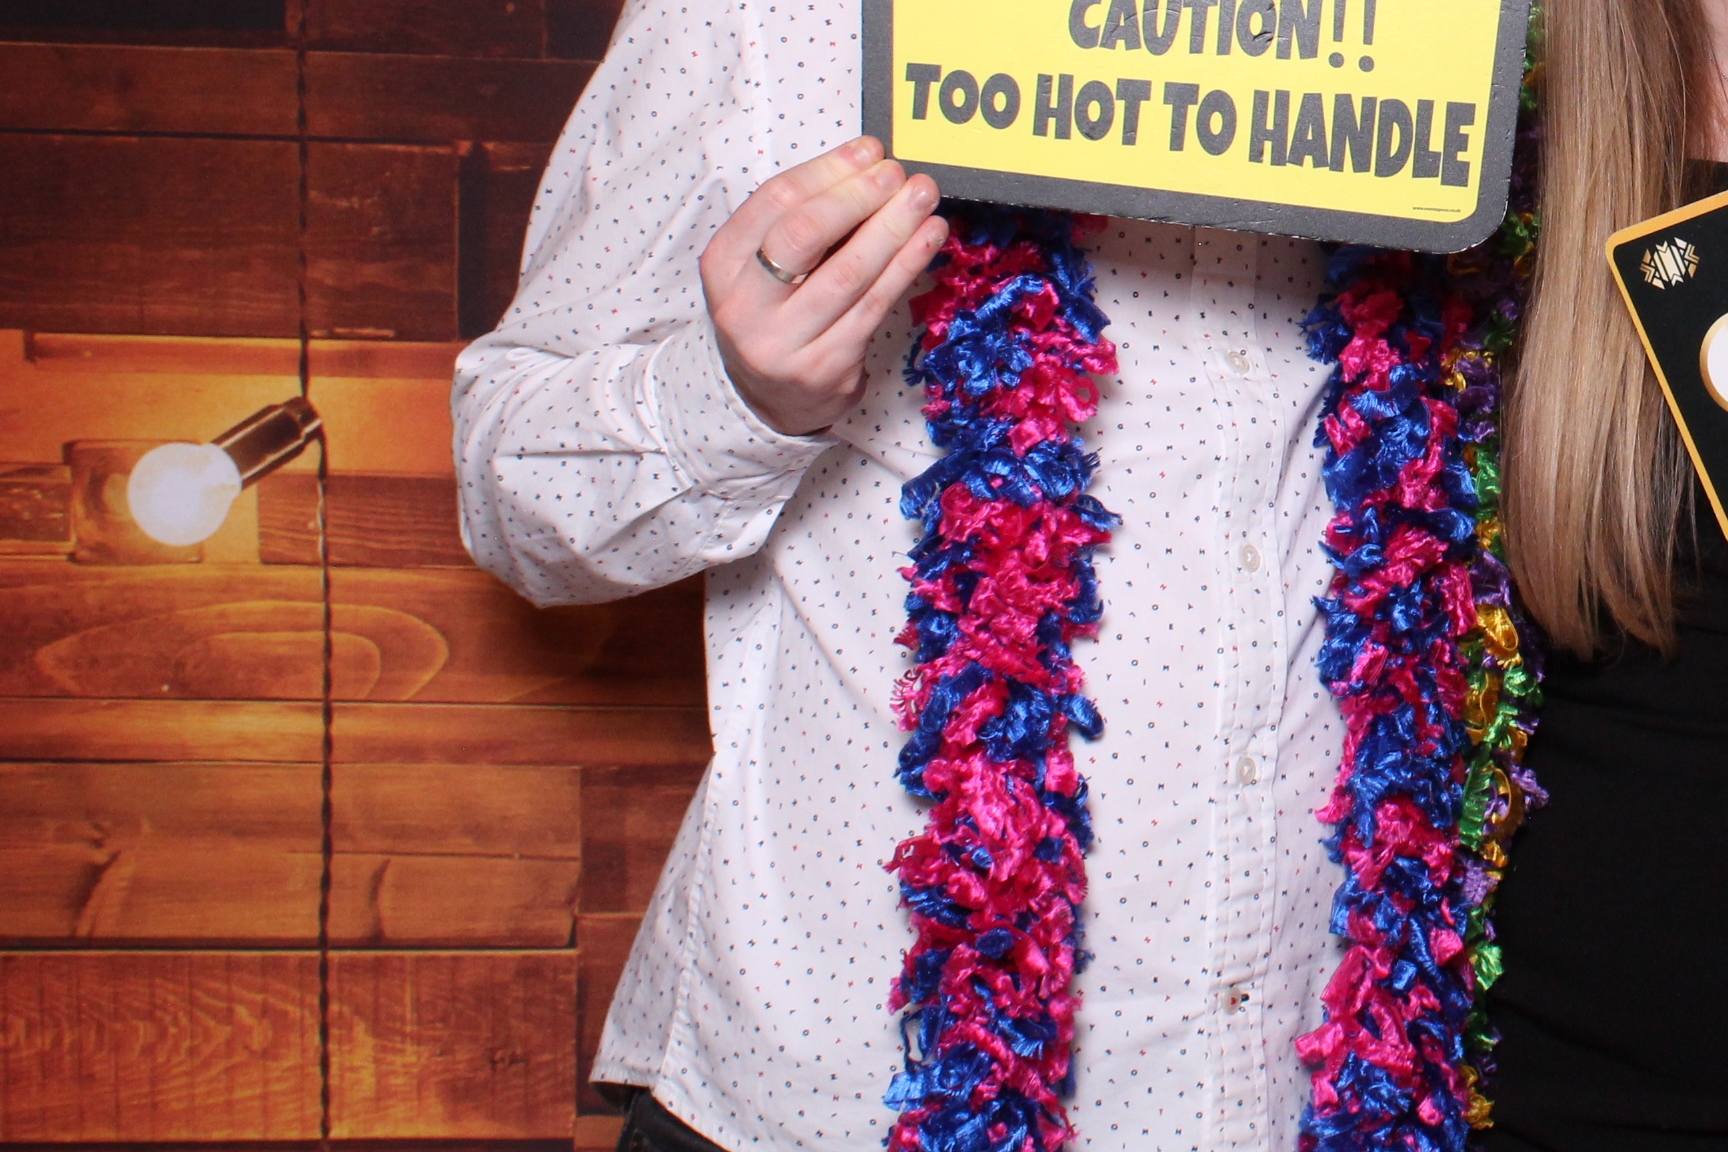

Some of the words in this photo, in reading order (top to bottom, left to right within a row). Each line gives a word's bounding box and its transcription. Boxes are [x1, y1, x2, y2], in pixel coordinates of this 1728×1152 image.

[905, 62, 1020, 129] TOO
[1032, 73, 1151, 145] HOT
[1163, 81, 1237, 156] TO
[1248, 89, 1476, 188] HANDLE
